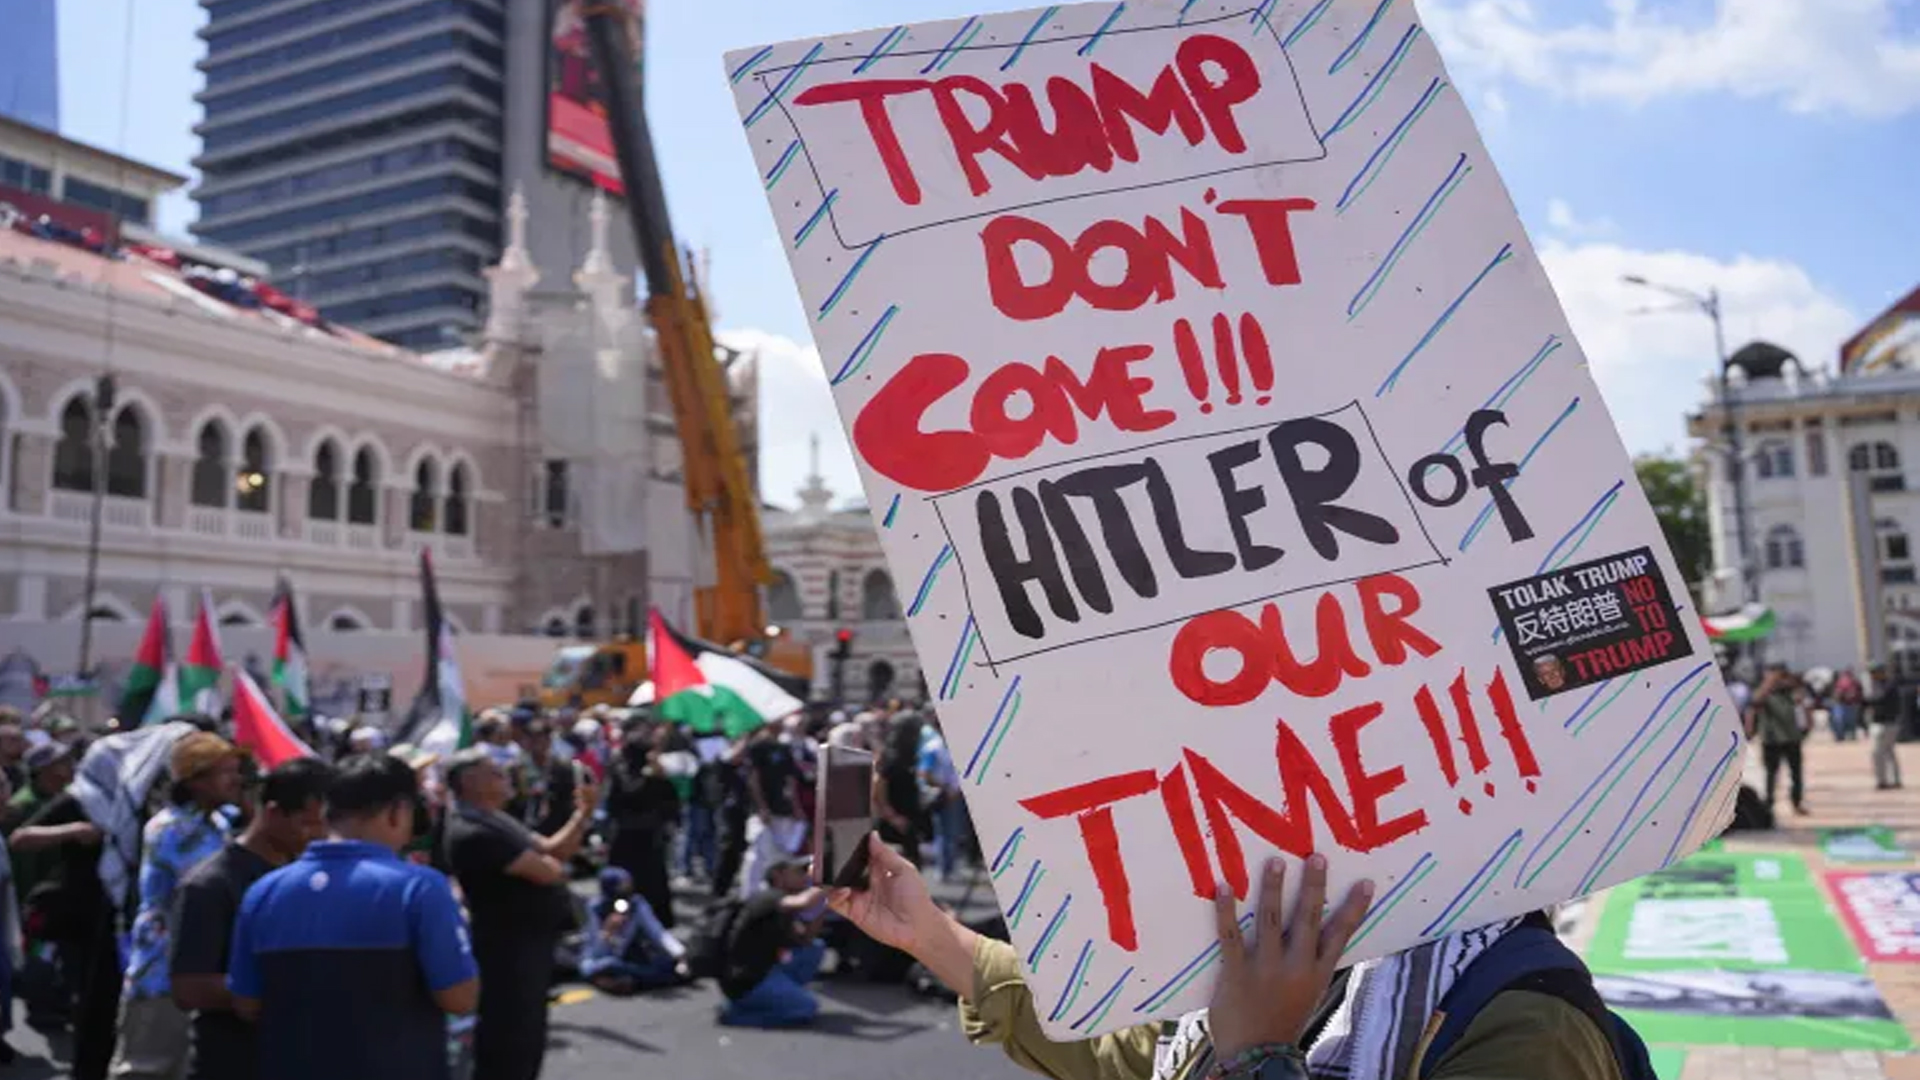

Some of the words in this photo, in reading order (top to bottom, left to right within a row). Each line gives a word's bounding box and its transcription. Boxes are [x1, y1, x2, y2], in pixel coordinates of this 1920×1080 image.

[794, 34, 1260, 206] TRUMP
[979, 188, 1316, 321] DON'T
[852, 312, 1276, 492] COME!!!
[976, 416, 1399, 640] HITLER
[1408, 408, 1535, 544] of
[1498, 574, 1573, 610] TOLAK
[1574, 554, 1648, 590] TRUMP
[1619, 574, 1657, 604] NO
[1168, 573, 1442, 708] OUR
[1513, 590, 1624, 645] 反特朗普
[1567, 631, 1674, 681] TRUMP
[1632, 602, 1667, 634] TO
[1018, 663, 1542, 952] TIME!!!
